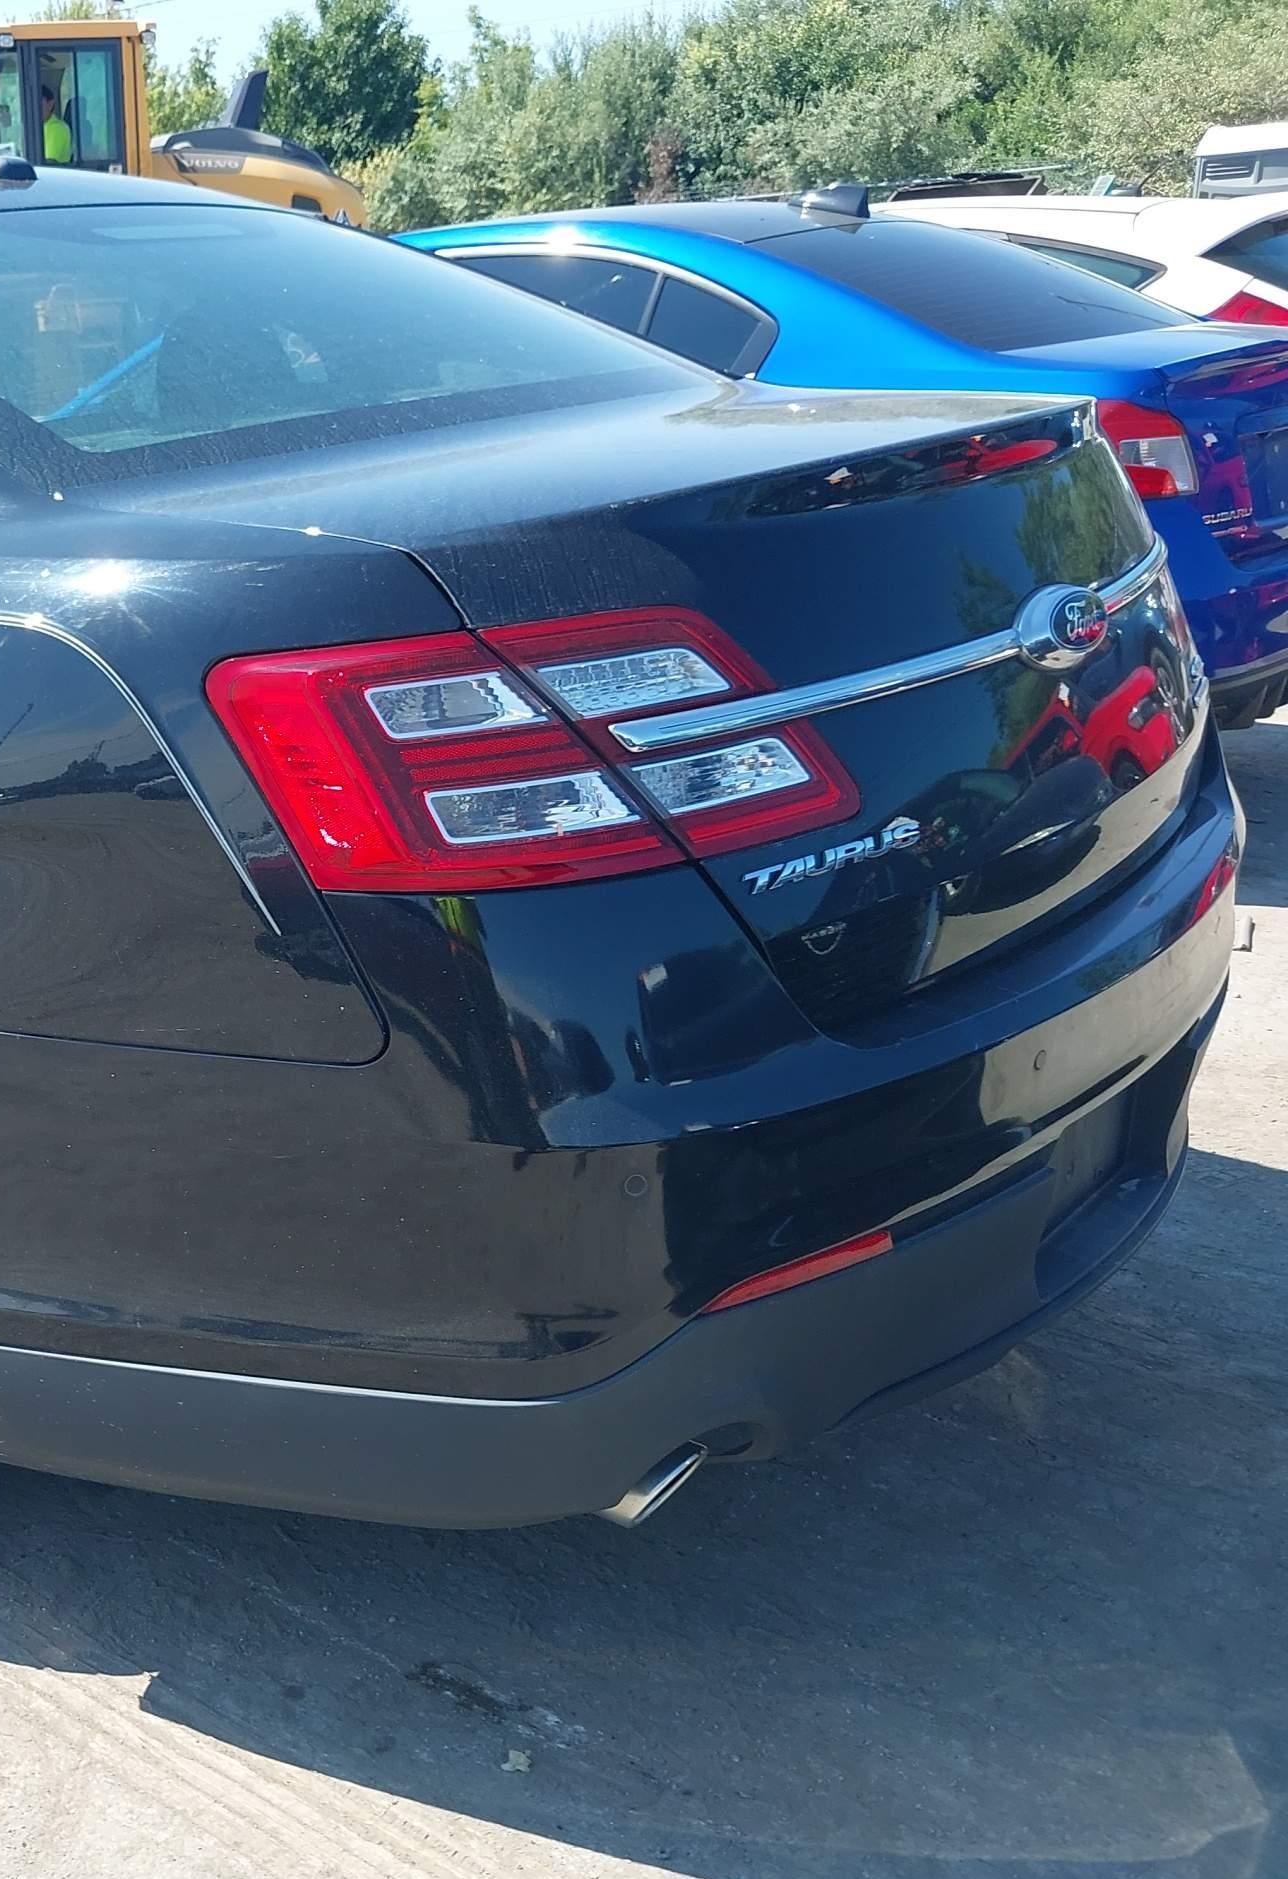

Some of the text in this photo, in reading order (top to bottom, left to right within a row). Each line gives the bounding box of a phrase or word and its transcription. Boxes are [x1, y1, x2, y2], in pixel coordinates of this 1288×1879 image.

[182, 158, 239, 168] VOLVO
[1201, 507, 1253, 525] SUBARU
[1064, 600, 1106, 641] Ford
[742, 821, 921, 895] TAURUS
